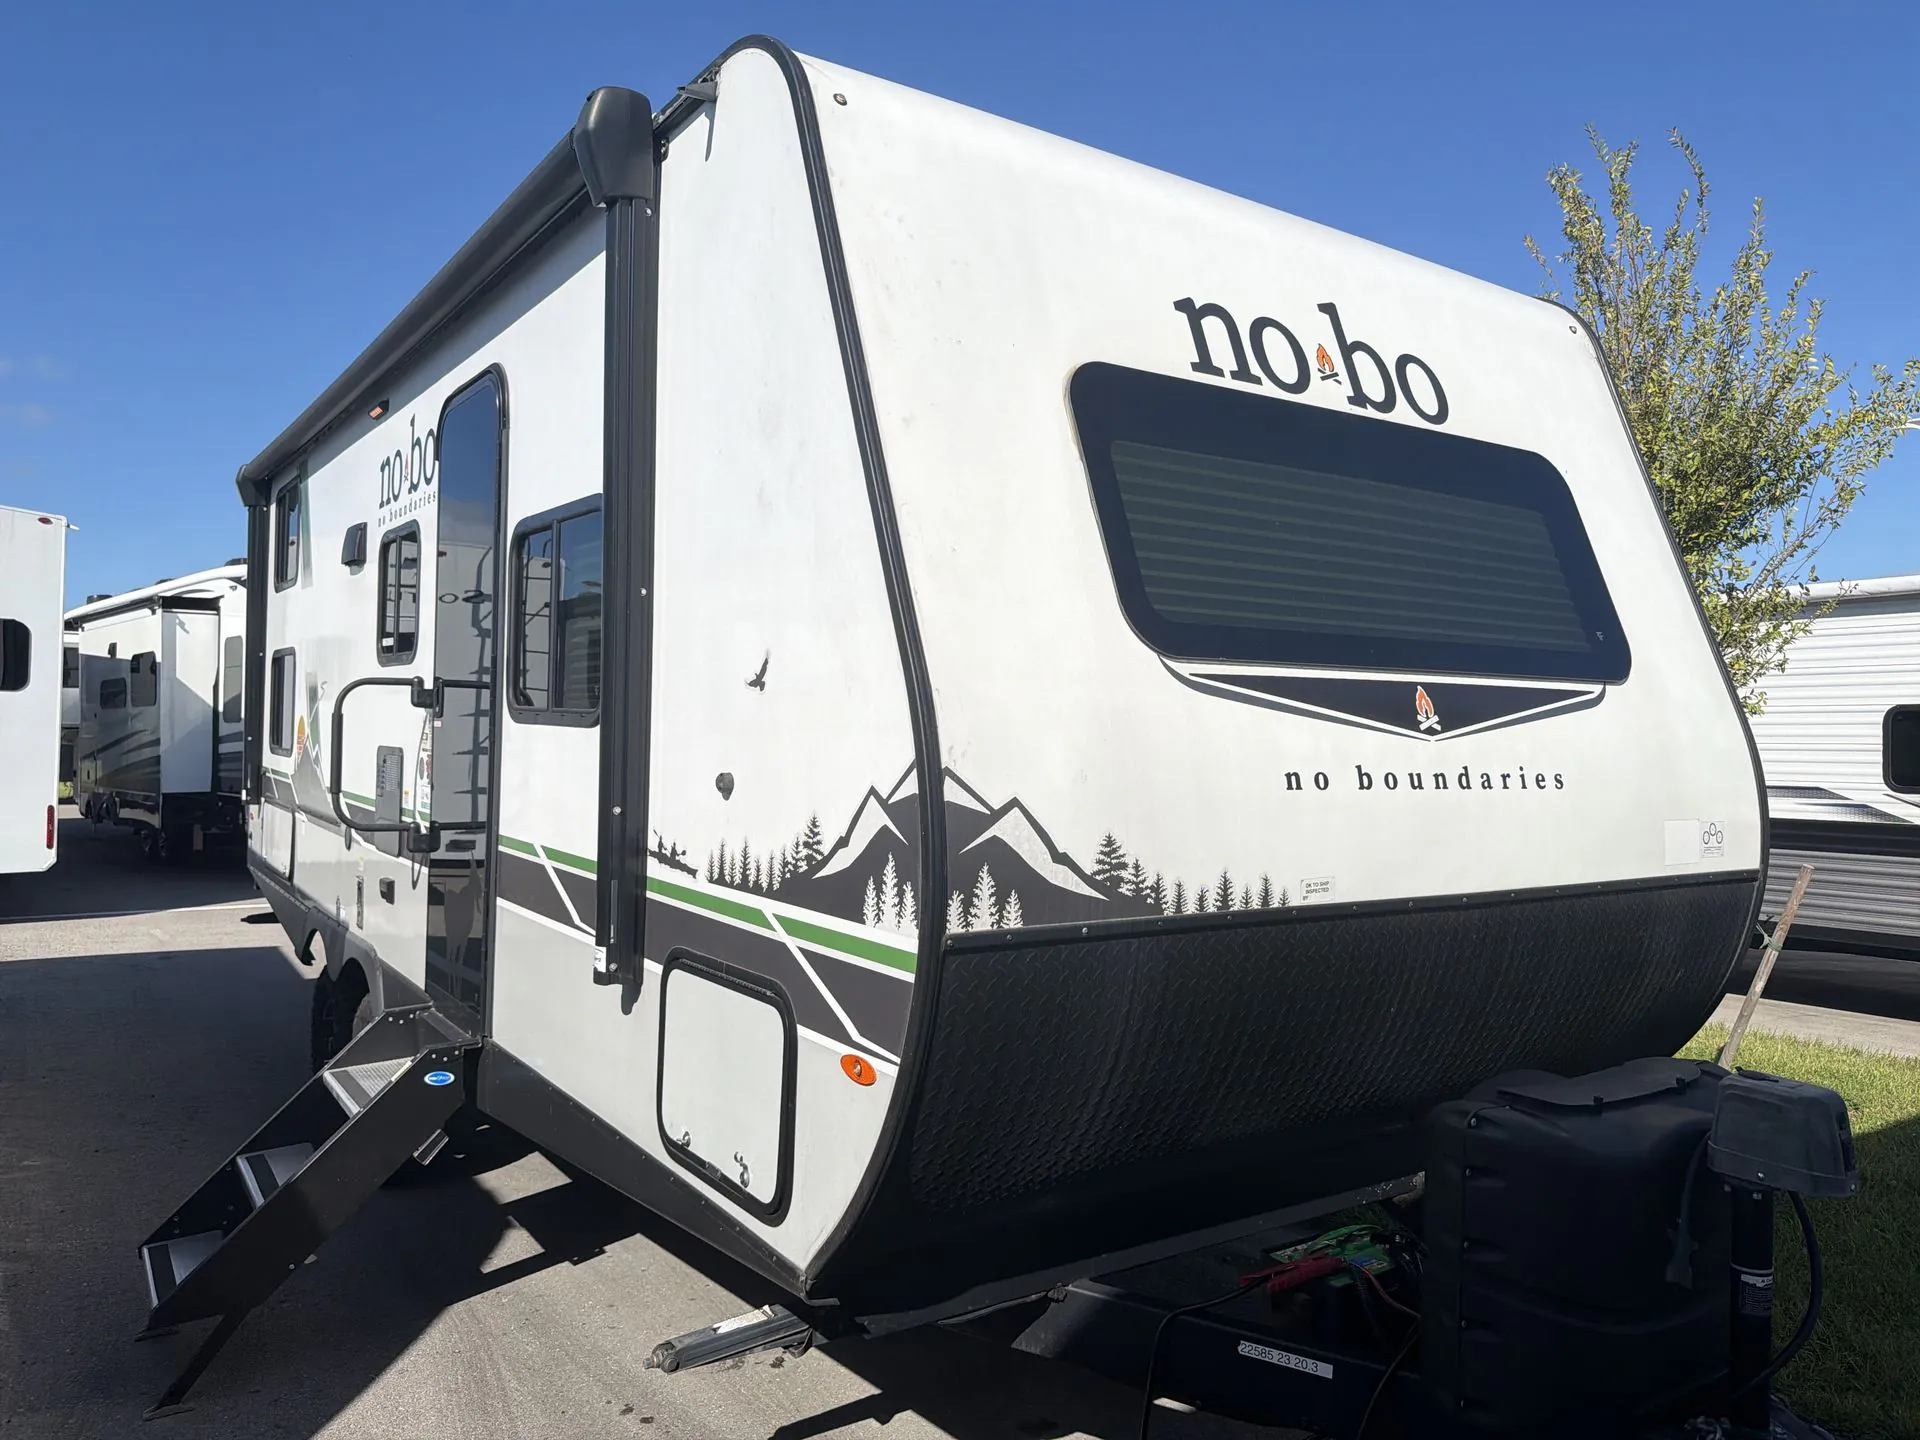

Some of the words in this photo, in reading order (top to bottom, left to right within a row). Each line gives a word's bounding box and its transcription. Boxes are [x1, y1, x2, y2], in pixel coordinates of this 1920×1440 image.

[378, 515, 386, 528] no
[389, 491, 436, 522] boundaries
[1284, 771, 1329, 790] no
[1355, 764, 1564, 790] boundaries
[1240, 1342, 1274, 1361] 22585
[1277, 1352, 1291, 1365] 23
[1294, 1357, 1319, 1373] 20.3
